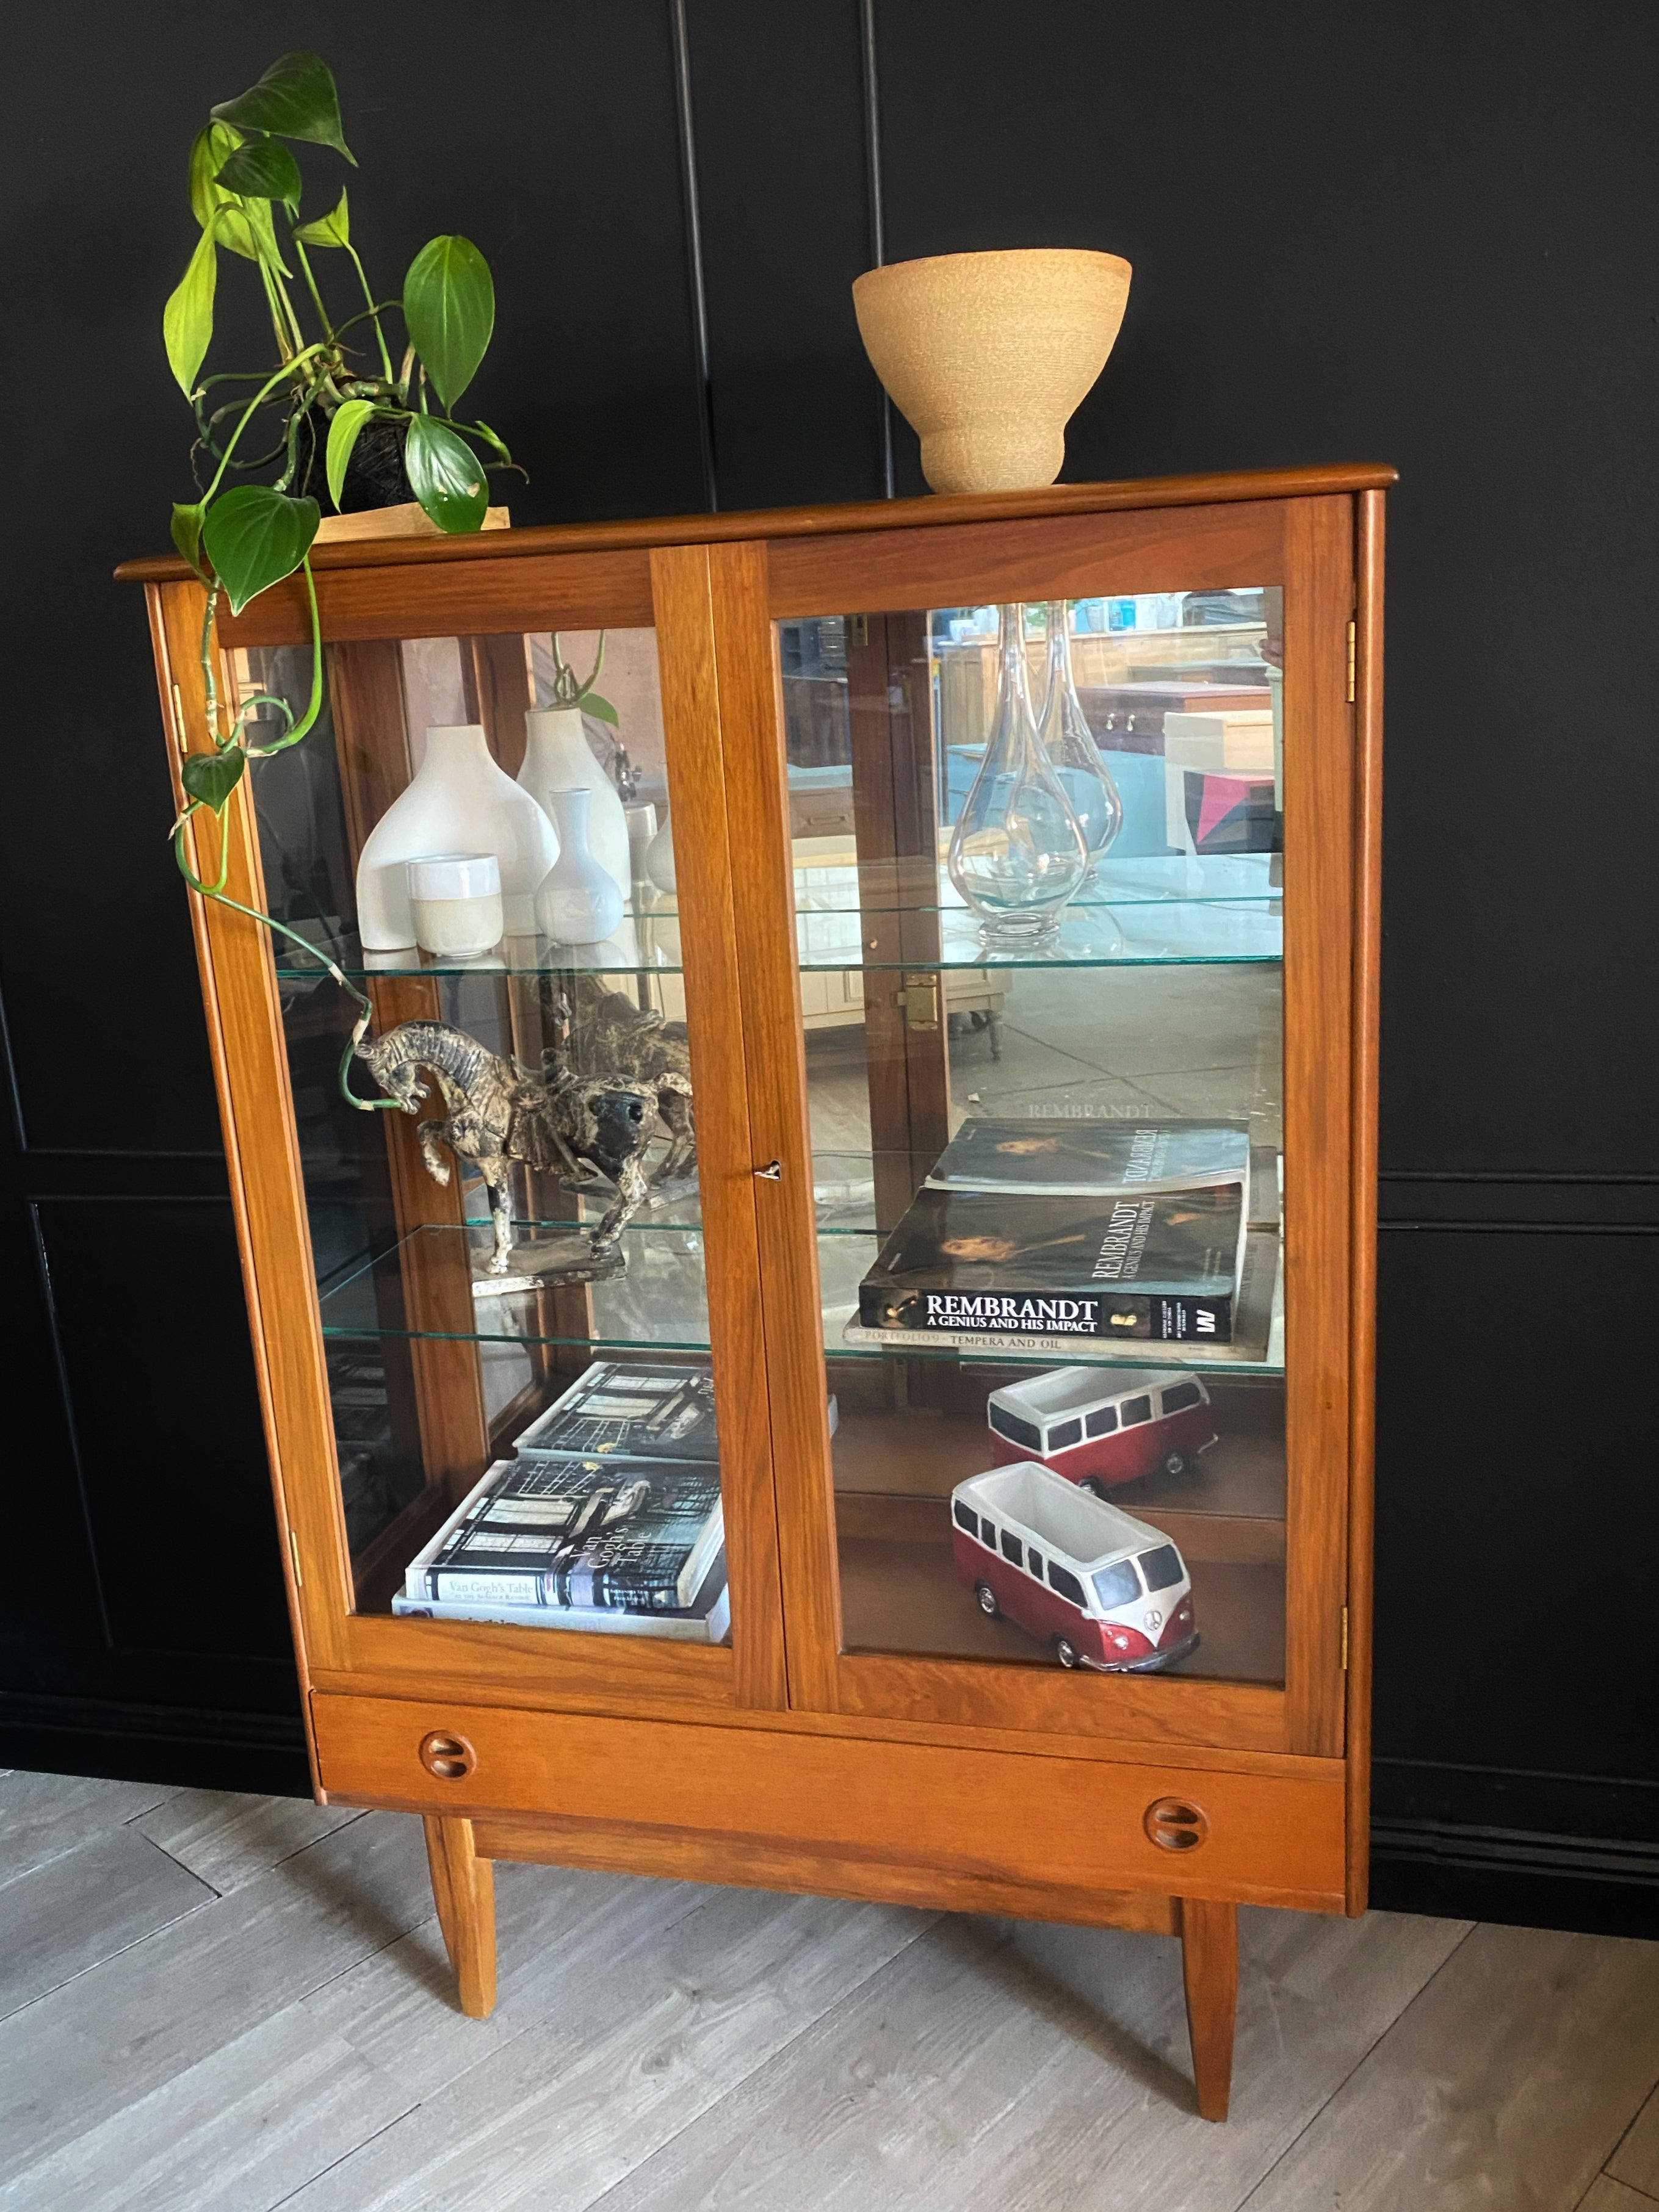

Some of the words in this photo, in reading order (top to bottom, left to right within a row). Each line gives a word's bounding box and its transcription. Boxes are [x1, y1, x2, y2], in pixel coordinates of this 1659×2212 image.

[1092, 1201, 1140, 1278] REMBRANDT
[1135, 1224, 1149, 1235] HIS
[1130, 1236, 1146, 1250] AND
[1123, 1251, 1142, 1274] GENIUS
[926, 1295, 1098, 1320] REMBRANDT
[927, 1316, 937, 1326] A
[938, 1316, 987, 1328] GENIUS
[989, 1318, 1019, 1329] AND
[1021, 1319, 1044, 1330] HIS
[1046, 1320, 1098, 1333] IMPACT
[864, 1331, 930, 1342] PORTFOLIO
[951, 1335, 1005, 1347] TEMPERA
[1010, 1338, 1036, 1349] AND
[1040, 1340, 1061, 1349] OIL
[569, 1537, 602, 1558] Van
[587, 1528, 629, 1568] Gogh's
[618, 1532, 651, 1562] Table
[449, 1582, 468, 1593] Van
[471, 1582, 505, 1594] Gogh's
[507, 1583, 533, 1593] Table
